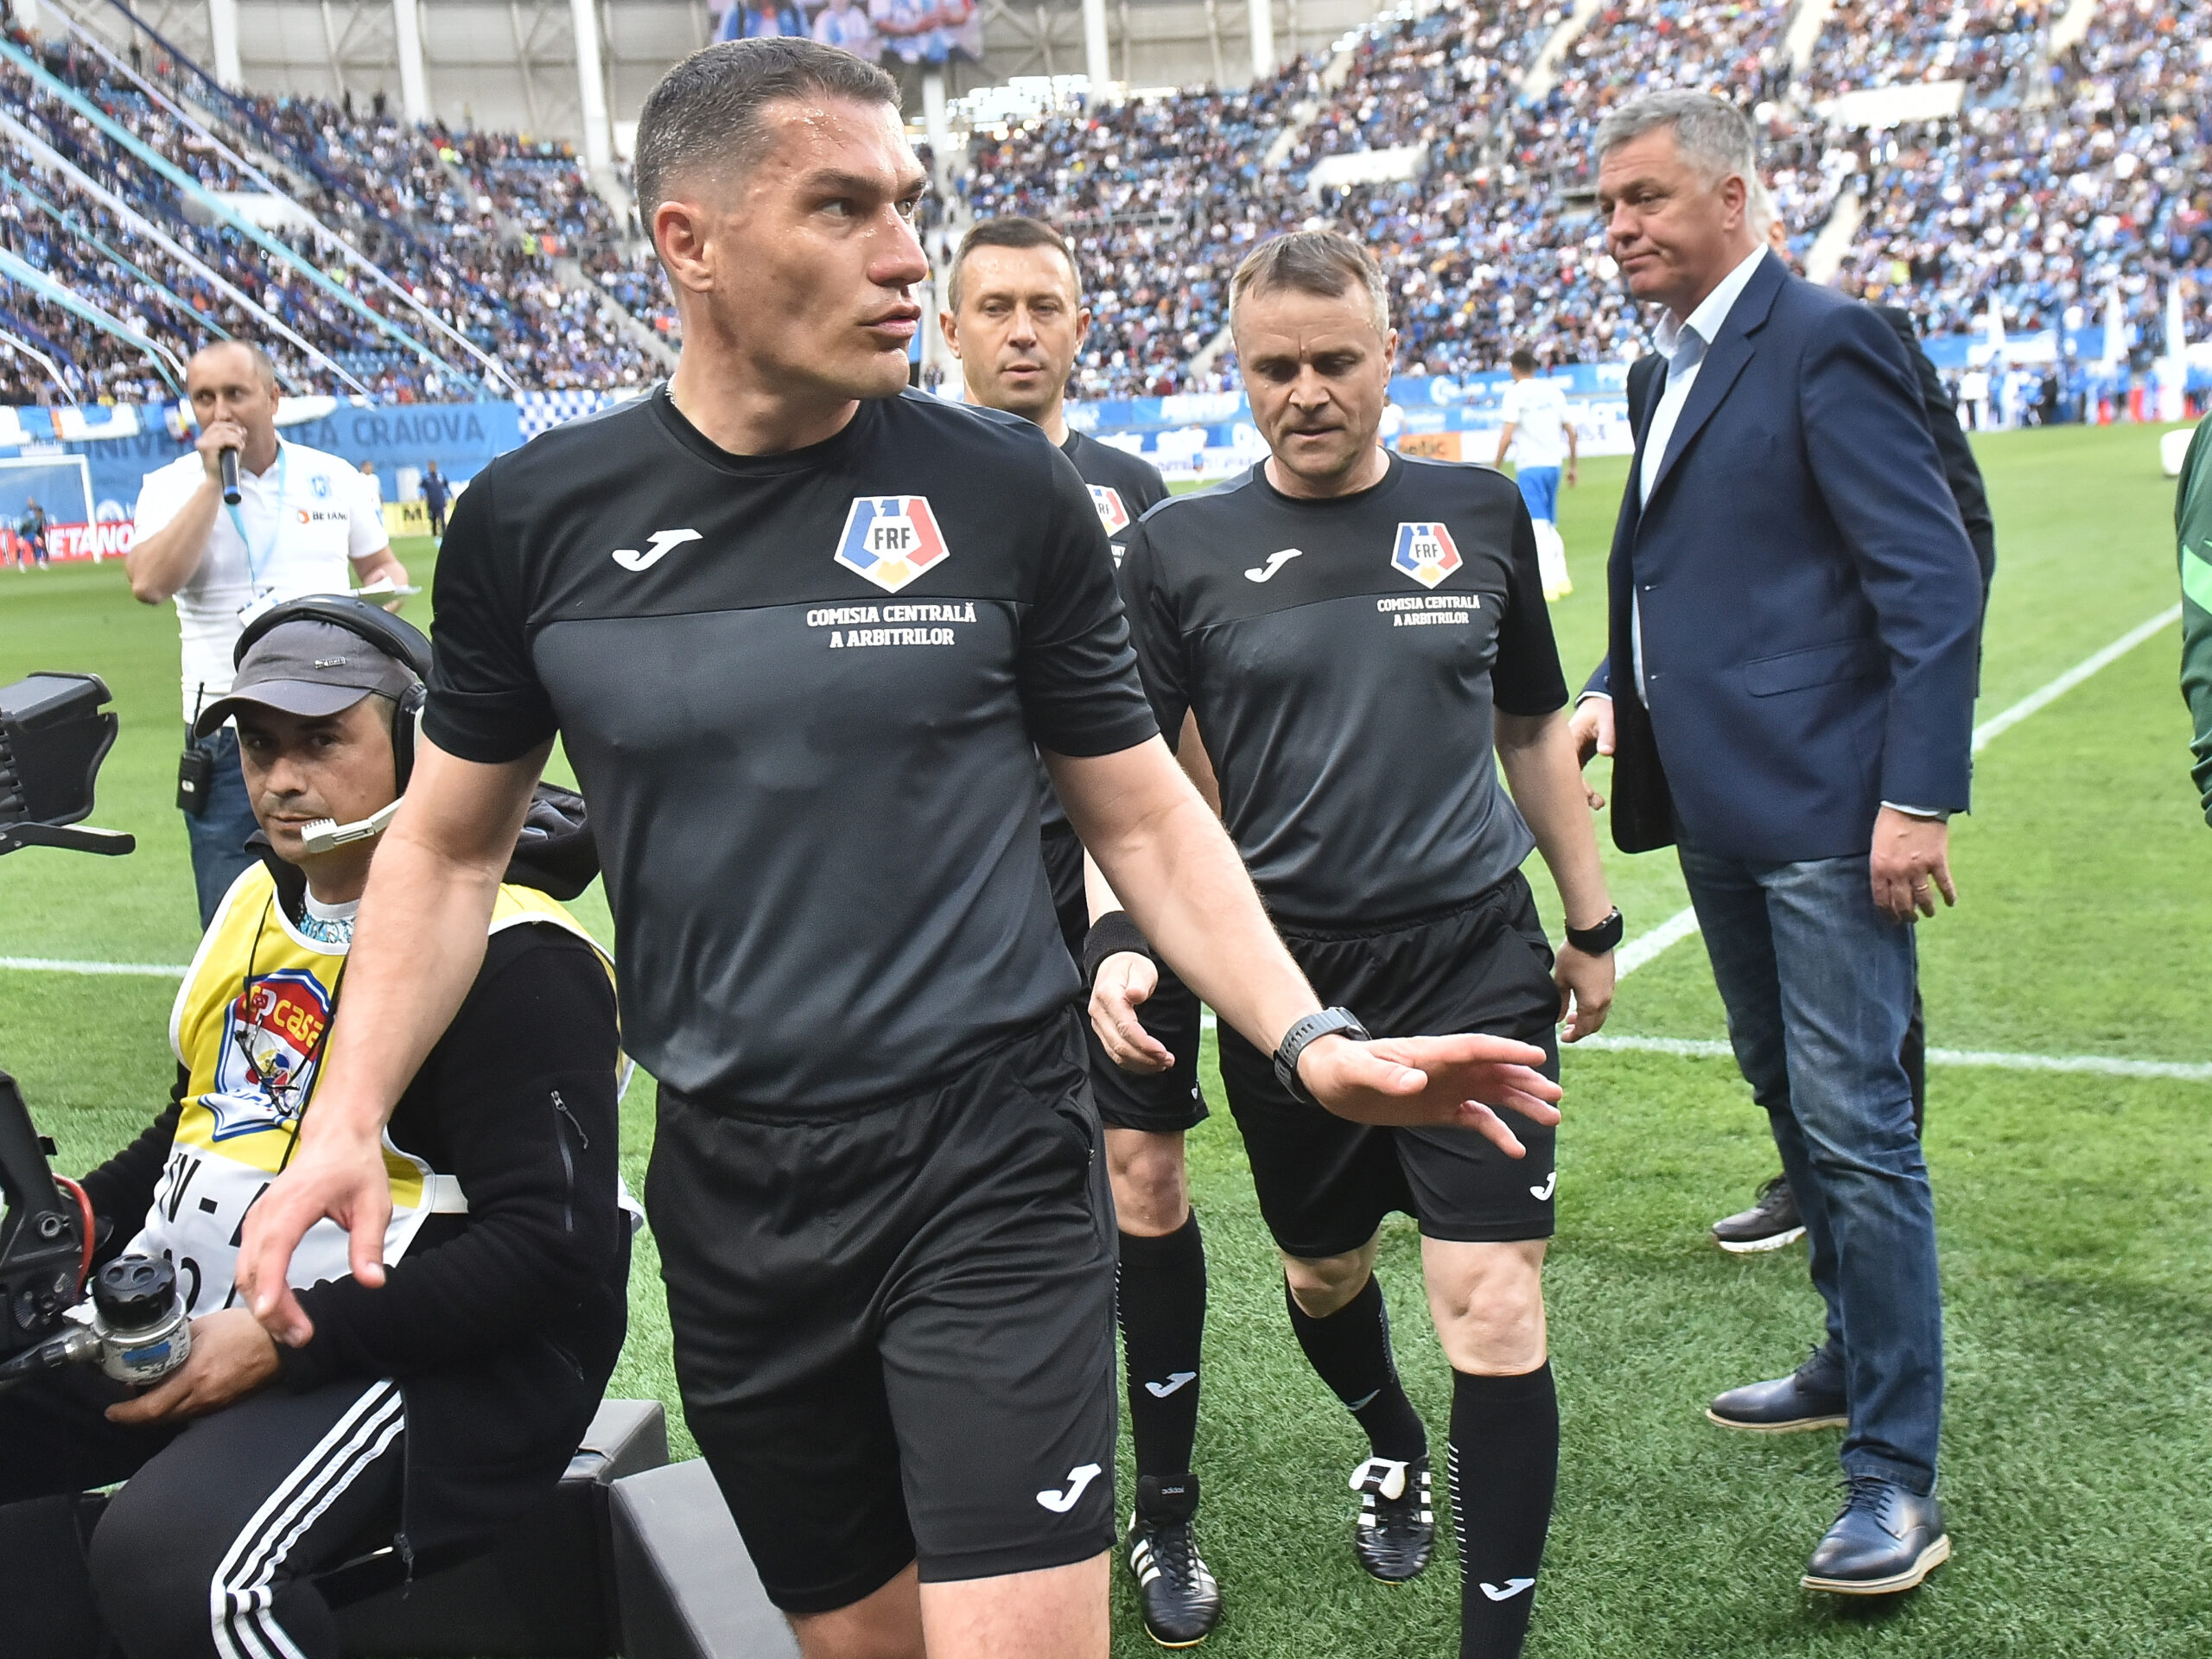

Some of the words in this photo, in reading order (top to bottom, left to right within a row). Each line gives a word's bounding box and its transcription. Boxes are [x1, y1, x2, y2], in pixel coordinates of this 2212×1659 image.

[352, 410, 486, 447] CRAIOVA
[874, 527, 911, 550] FRF
[1414, 543, 1439, 558] FRF
[1376, 597, 1425, 613] COMISIA
[1424, 594, 1481, 609] CENTRALĂ
[806, 607, 880, 627] COMISIA
[882, 601, 977, 623] CENTRALĂ
[1393, 613, 1403, 627] A
[1403, 612, 1470, 626] ARBITRILOR
[830, 631, 844, 648] A
[846, 628, 955, 648] ARBITRILOR
